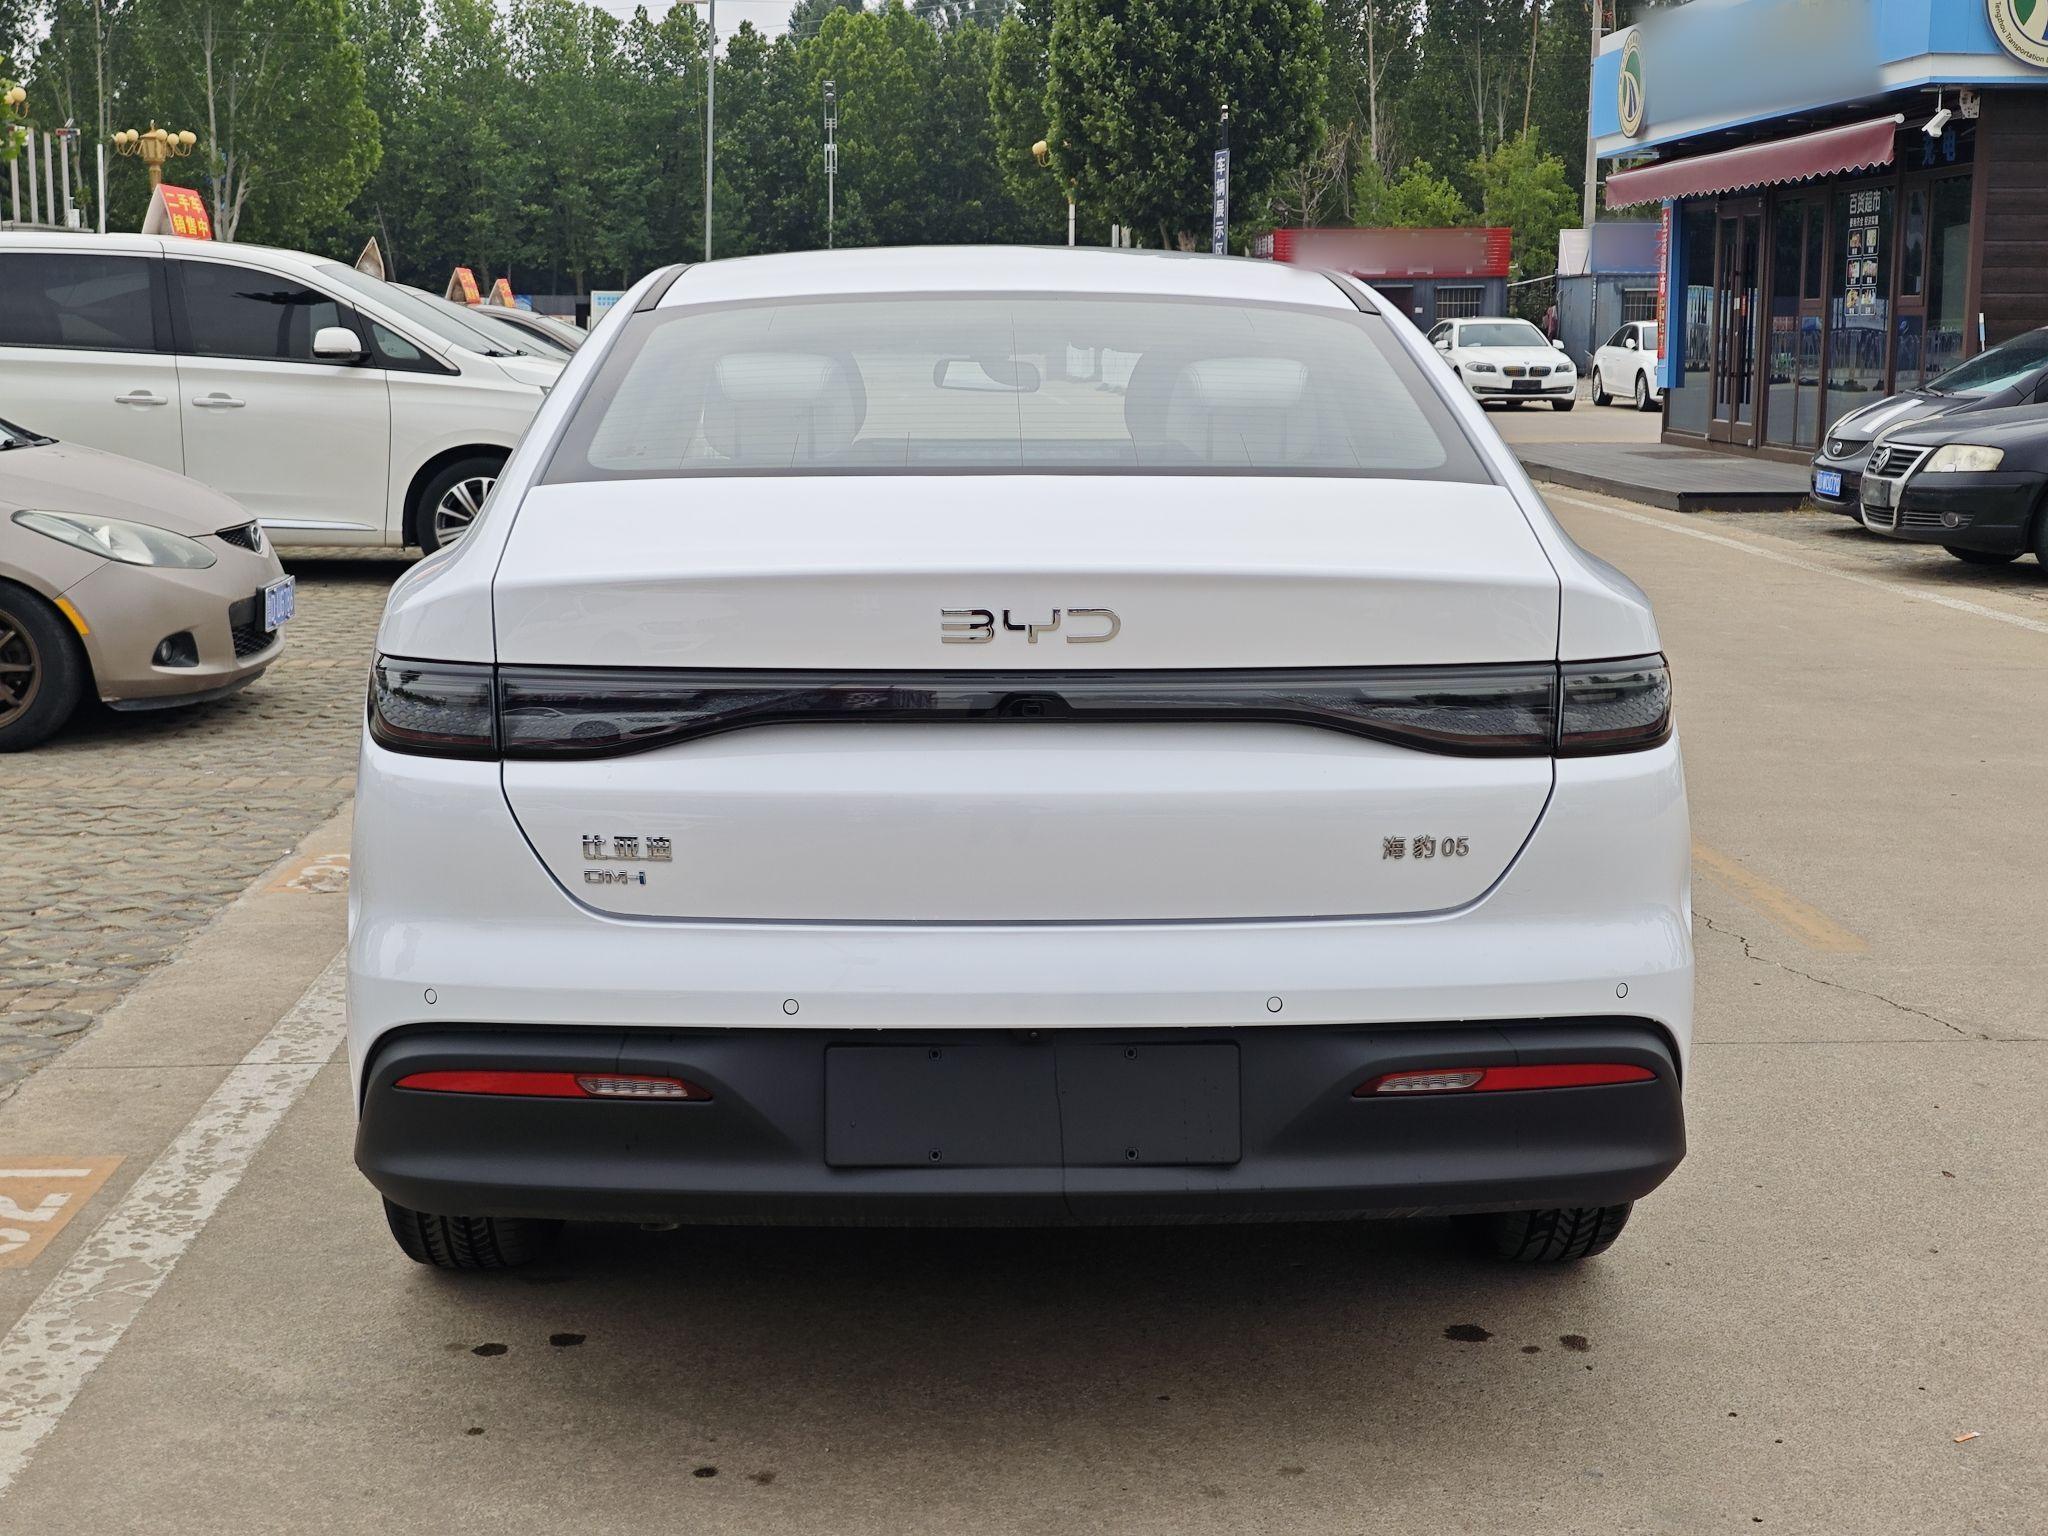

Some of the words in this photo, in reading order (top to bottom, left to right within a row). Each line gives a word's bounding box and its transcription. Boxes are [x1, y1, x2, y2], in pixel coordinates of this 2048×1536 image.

[1994, 1, 2007, 34] Tengzhou
[2005, 32, 2045, 62] Transportation
[164, 192, 202, 213] 二手车
[1215, 156, 1227, 255] 车辆展示区
[1849, 190, 1881, 214] 百货超市
[173, 213, 209, 237] 销售中
[941, 607, 1122, 643] BYD
[582, 834, 673, 861] 比亚迪
